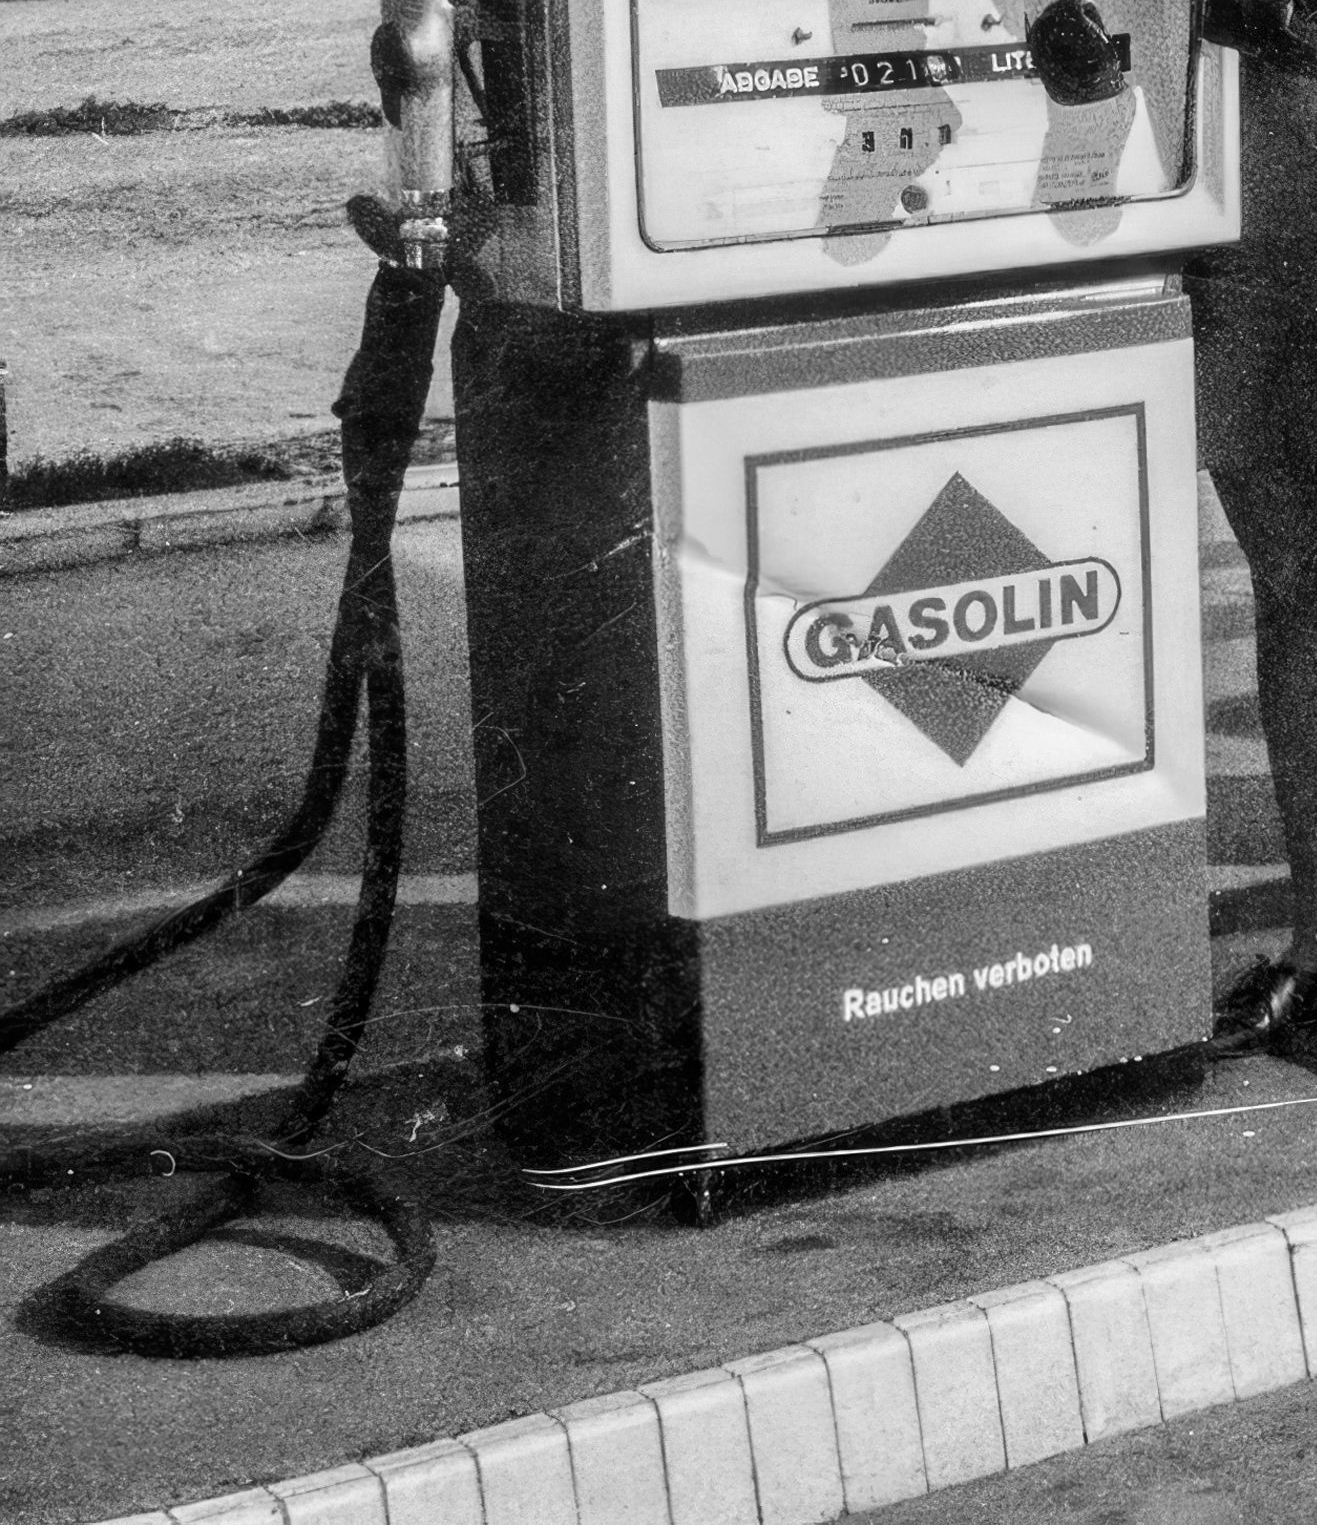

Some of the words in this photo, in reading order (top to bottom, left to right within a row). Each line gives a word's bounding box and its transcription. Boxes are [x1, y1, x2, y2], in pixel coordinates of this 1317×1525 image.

[804, 570, 1099, 668] GASOLIN
[843, 972, 965, 1022] Rauchen
[973, 943, 1093, 991] verboten
